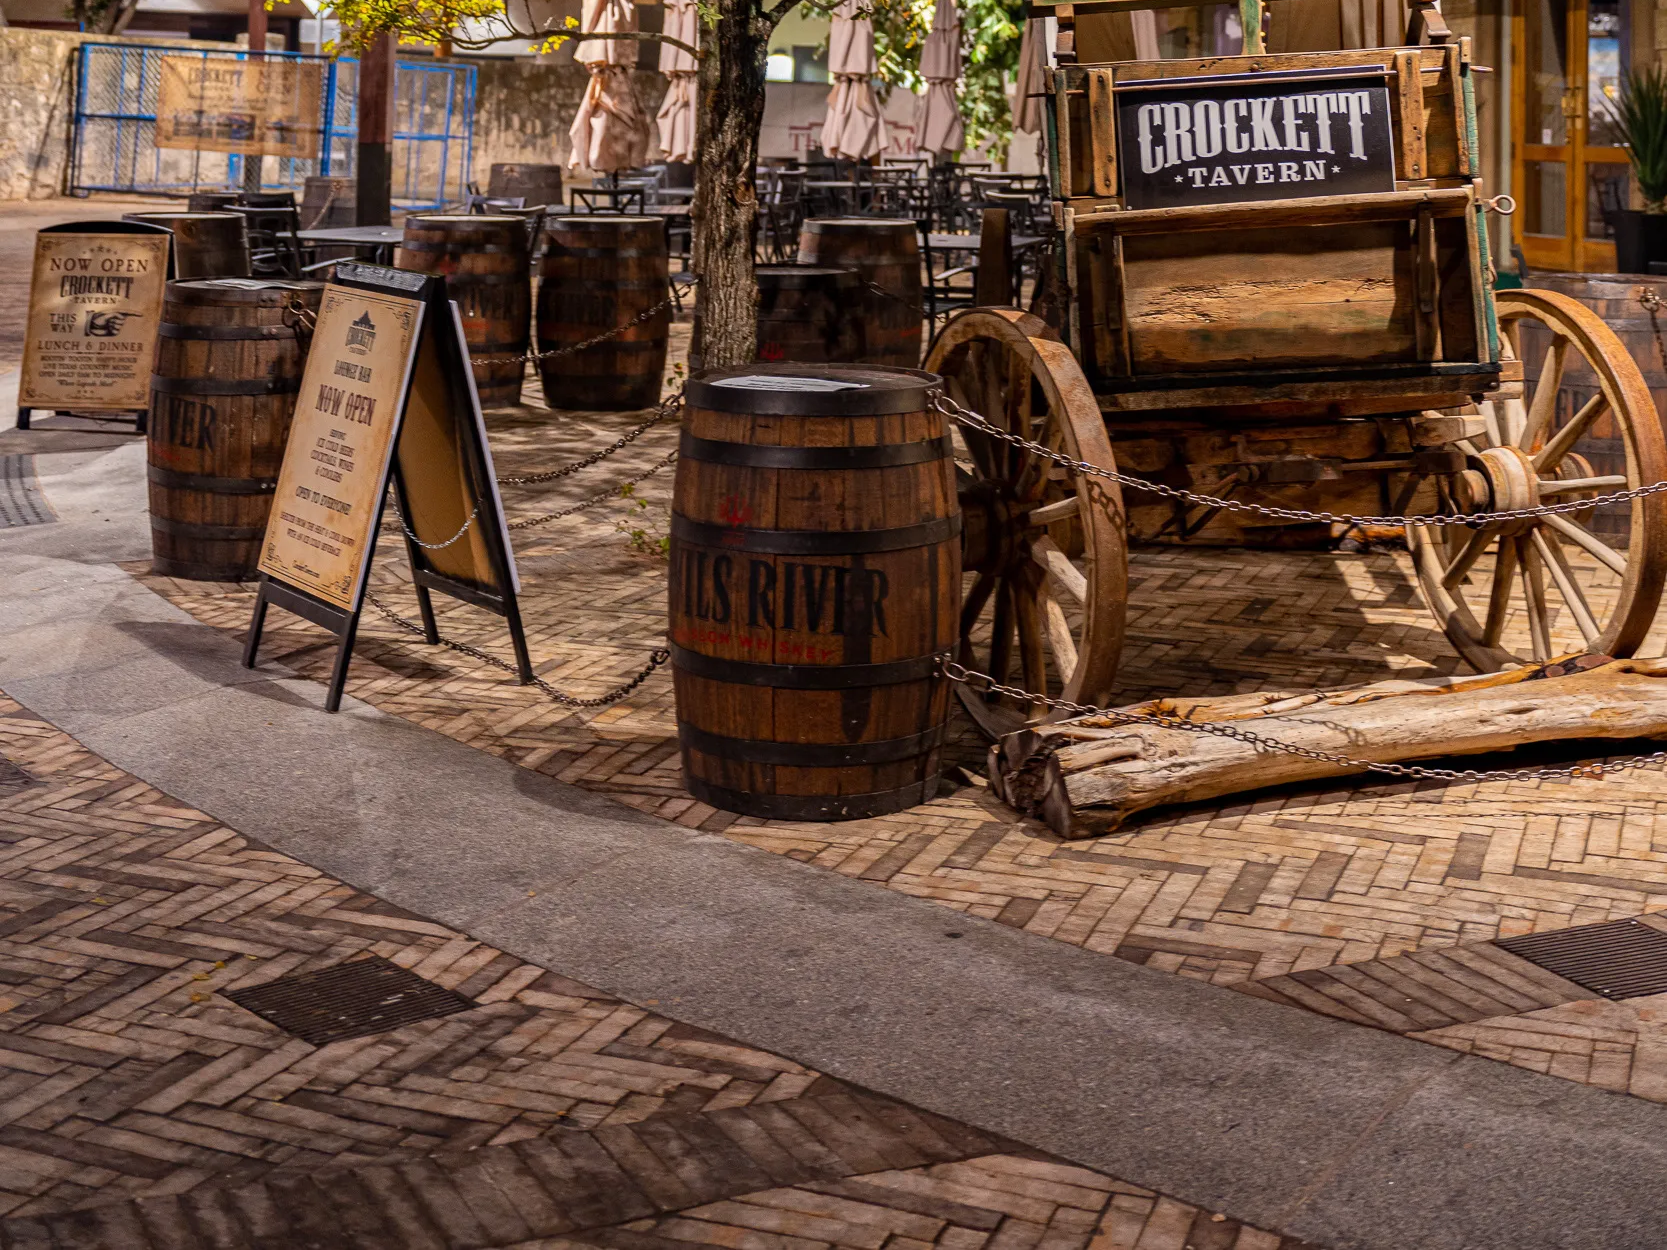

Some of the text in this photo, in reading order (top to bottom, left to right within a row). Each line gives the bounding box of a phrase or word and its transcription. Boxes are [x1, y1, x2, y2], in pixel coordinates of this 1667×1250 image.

[1137, 91, 1371, 174] CROCKETT
[1187, 160, 1326, 188] TAVERN
[50, 257, 148, 272] NOW OPEN
[60, 275, 134, 299] CROCKETT
[74, 296, 117, 304] TAVERN
[49, 313, 77, 323] THIS
[50, 323, 75, 333] WAY
[38, 340, 79, 351] LUNCH
[99, 341, 144, 352] DINNER
[315, 384, 377, 427] NOW OPEN
